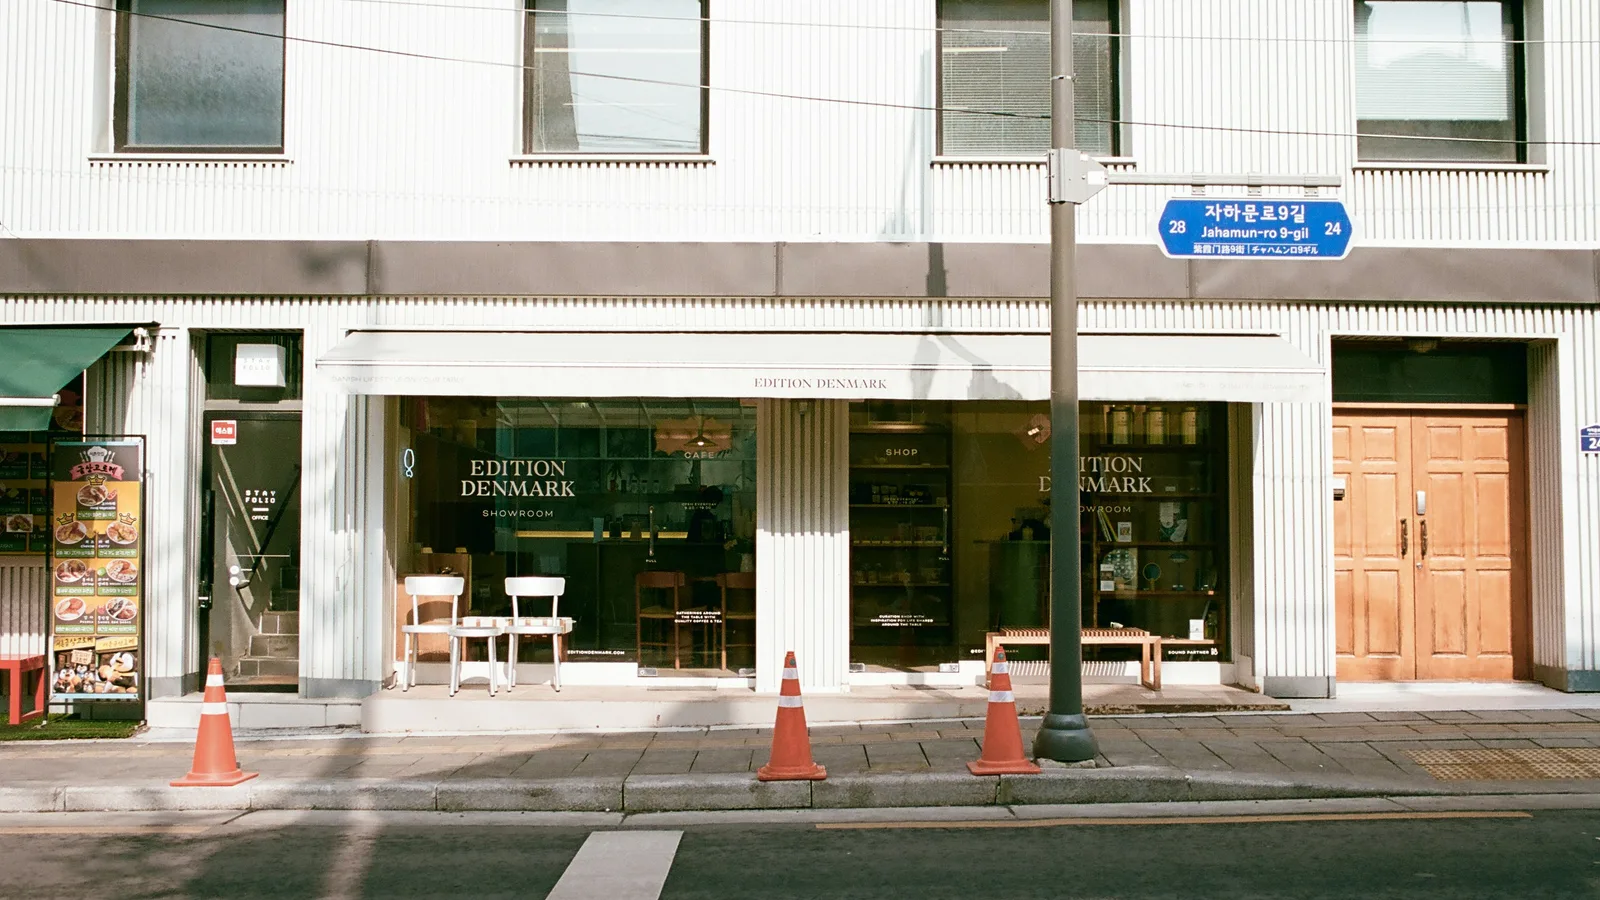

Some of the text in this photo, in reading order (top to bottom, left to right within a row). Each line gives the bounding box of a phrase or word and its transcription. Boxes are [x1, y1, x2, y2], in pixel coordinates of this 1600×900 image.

[1204, 203, 1306, 224] 자하문로9길
[1168, 220, 1186, 234] 28
[1200, 226, 1309, 241] Jahamun-ro 9-gil
[1324, 221, 1342, 236] 24
[754, 378, 887, 389] EDITION DENMARK
[683, 451, 715, 459] CAFE
[885, 448, 918, 456] SHOP
[470, 459, 567, 477] EDITION
[460, 480, 576, 497] DENMARK
[1038, 476, 1153, 493] DNMARK
[244, 489, 277, 497] STAY
[244, 496, 277, 504] FOLIO
[482, 509, 554, 518] SHOWROOM
